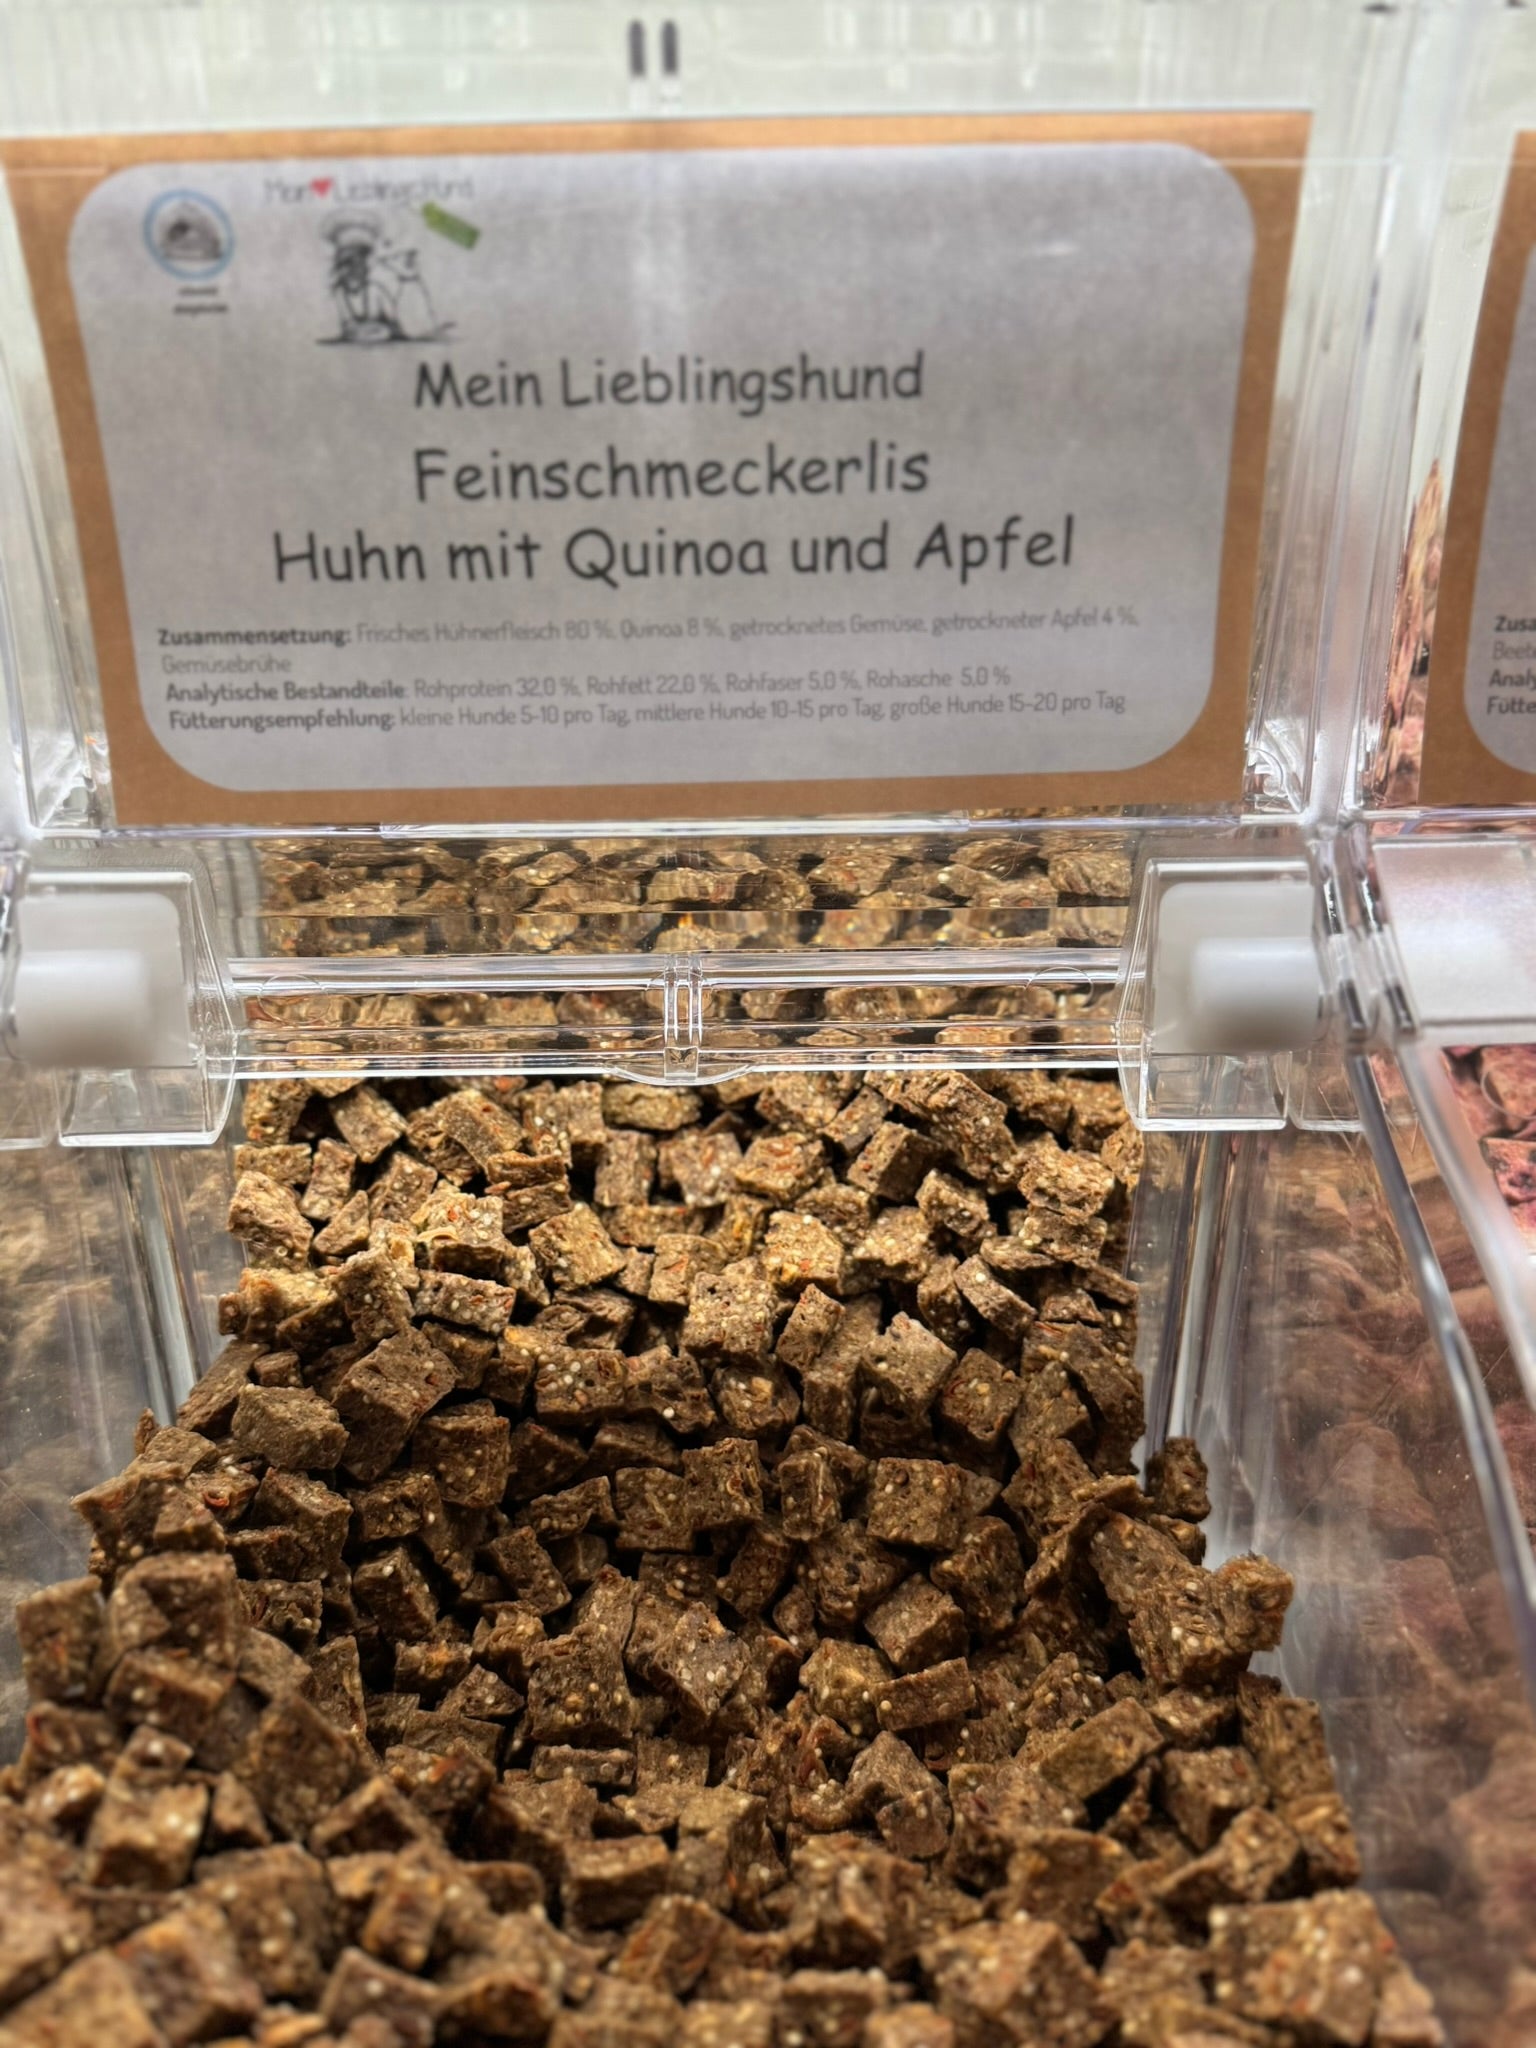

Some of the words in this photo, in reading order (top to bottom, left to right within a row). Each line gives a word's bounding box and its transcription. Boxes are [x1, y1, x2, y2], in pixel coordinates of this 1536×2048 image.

[414, 361, 542, 409] Mein
[560, 350, 925, 418] Lieblingshund
[413, 440, 931, 504] Feinschmeckerlis
[274, 529, 426, 584] Huhn
[447, 529, 541, 582] mit
[564, 526, 768, 589] Quinoa
[791, 521, 888, 576] und
[915, 514, 1075, 585] Apfel
[157, 627, 352, 648] Zusammensetzung:
[356, 622, 430, 643] Frisches
[434, 619, 561, 642] Hühnerfleisch
[564, 620, 590, 640] 80
[620, 618, 684, 639] Quinoa
[687, 617, 699, 637] 8
[729, 615, 846, 641] getrocknetes
[931, 609, 1046, 637] getrockneter
[1051, 606, 1098, 633] Apfel
[1102, 606, 1113, 625] 4
[161, 652, 292, 674] Gemüsebrühe
[166, 681, 278, 706] Analytische
[414, 676, 512, 702] Rohprotein
[516, 676, 556, 698] 32,0
[587, 674, 651, 695] Rohfett
[656, 674, 695, 695] 22,0
[726, 671, 803, 693] Rohfaser
[808, 670, 837, 691] 5,0
[867, 667, 952, 689] Rohasche
[960, 666, 988, 688] 5,0
[992, 665, 1011, 686] %
[168, 706, 396, 734] Fütterungsempfehlung:
[400, 705, 453, 727] kleine
[458, 704, 517, 725] Hunde
[520, 704, 559, 724] 5-10
[564, 707, 593, 728] pro
[597, 703, 631, 728] Tag,
[635, 701, 704, 722] mittlere
[709, 699, 766, 720] Hunde
[771, 698, 814, 719] 10-15
[818, 702, 848, 722] pro
[854, 697, 885, 722] Tag,
[890, 694, 942, 721] große
[947, 693, 1004, 714] Hunde
[1008, 691, 1057, 713] 15-20
[1062, 696, 1092, 716] pro
[1095, 690, 1126, 715] Tag
